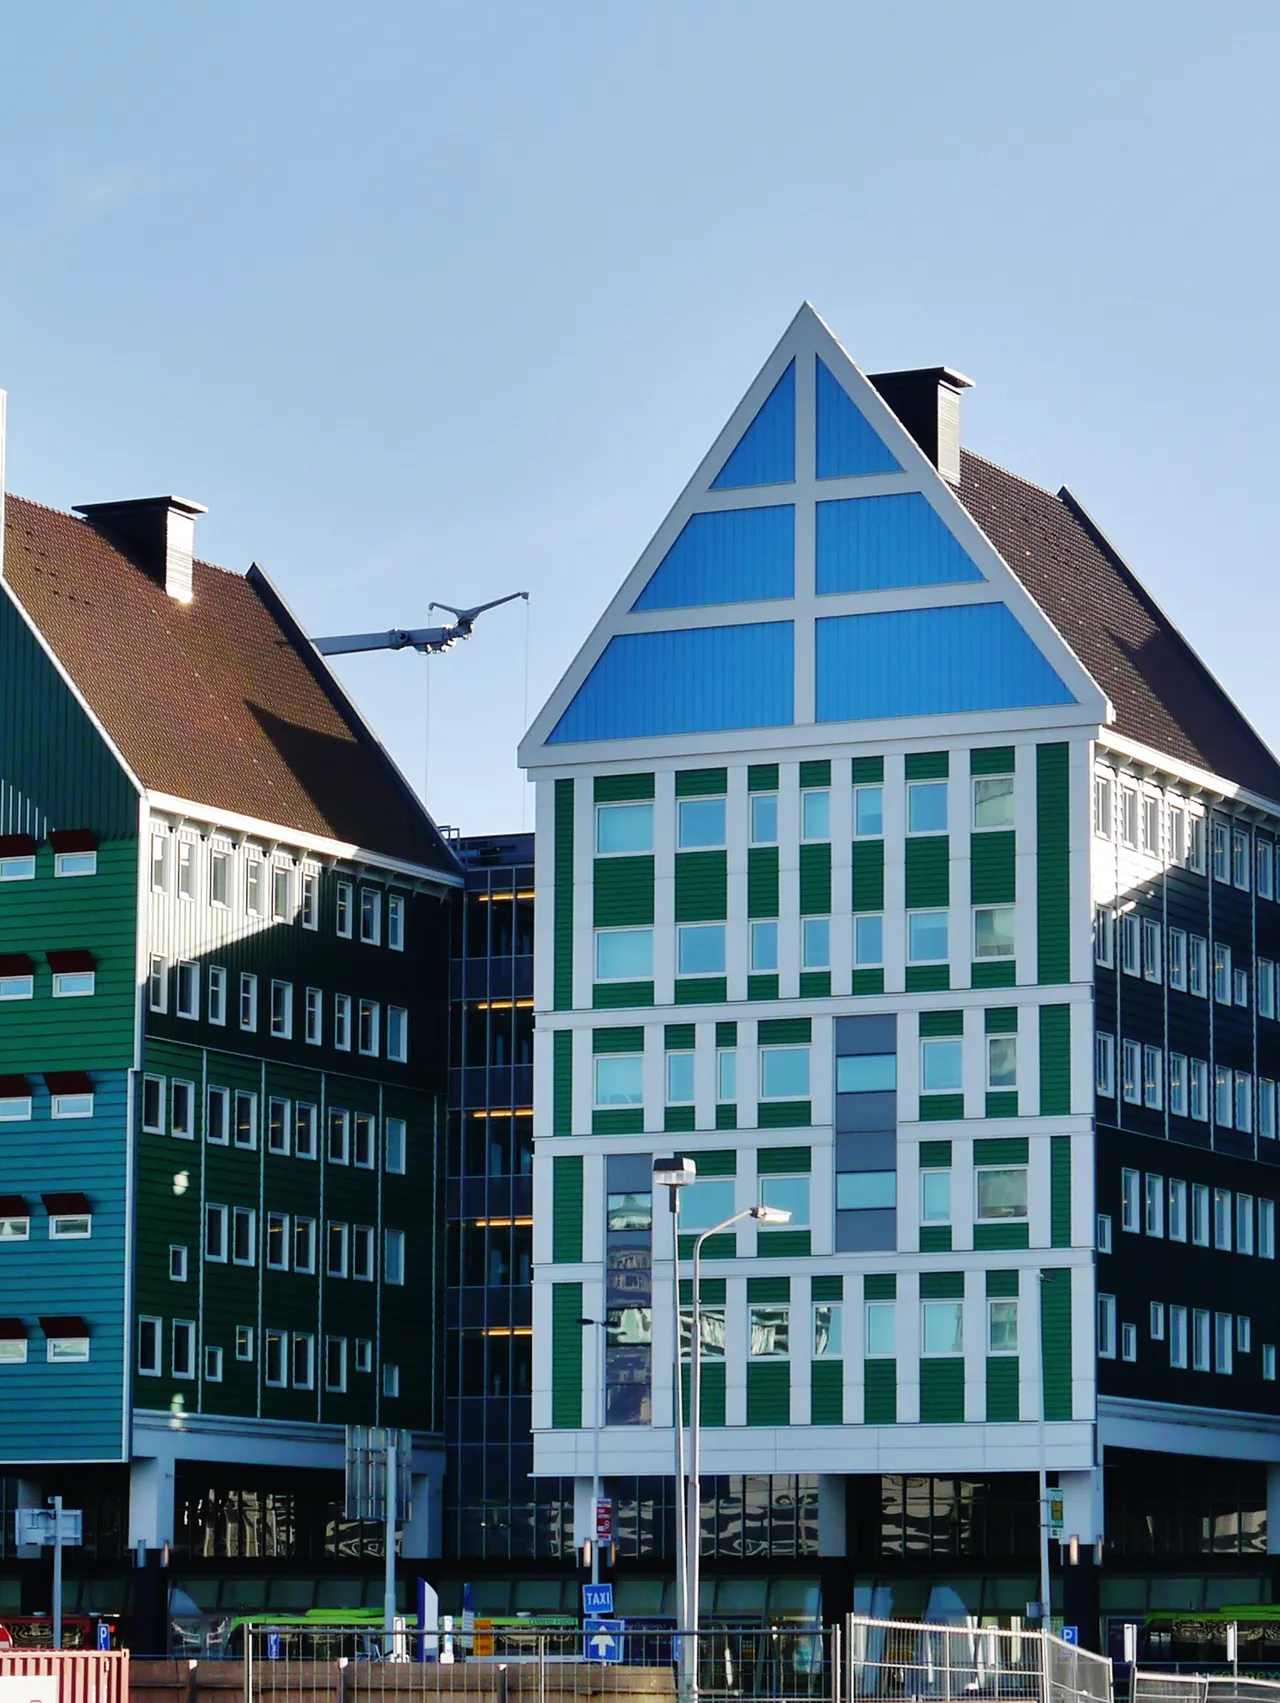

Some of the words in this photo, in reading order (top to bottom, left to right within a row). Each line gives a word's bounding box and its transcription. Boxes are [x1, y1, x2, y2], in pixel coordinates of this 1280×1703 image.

[586, 1592, 610, 1606] TAXI
[101, 1627, 107, 1645] P
[1064, 1629, 1073, 1644] P
